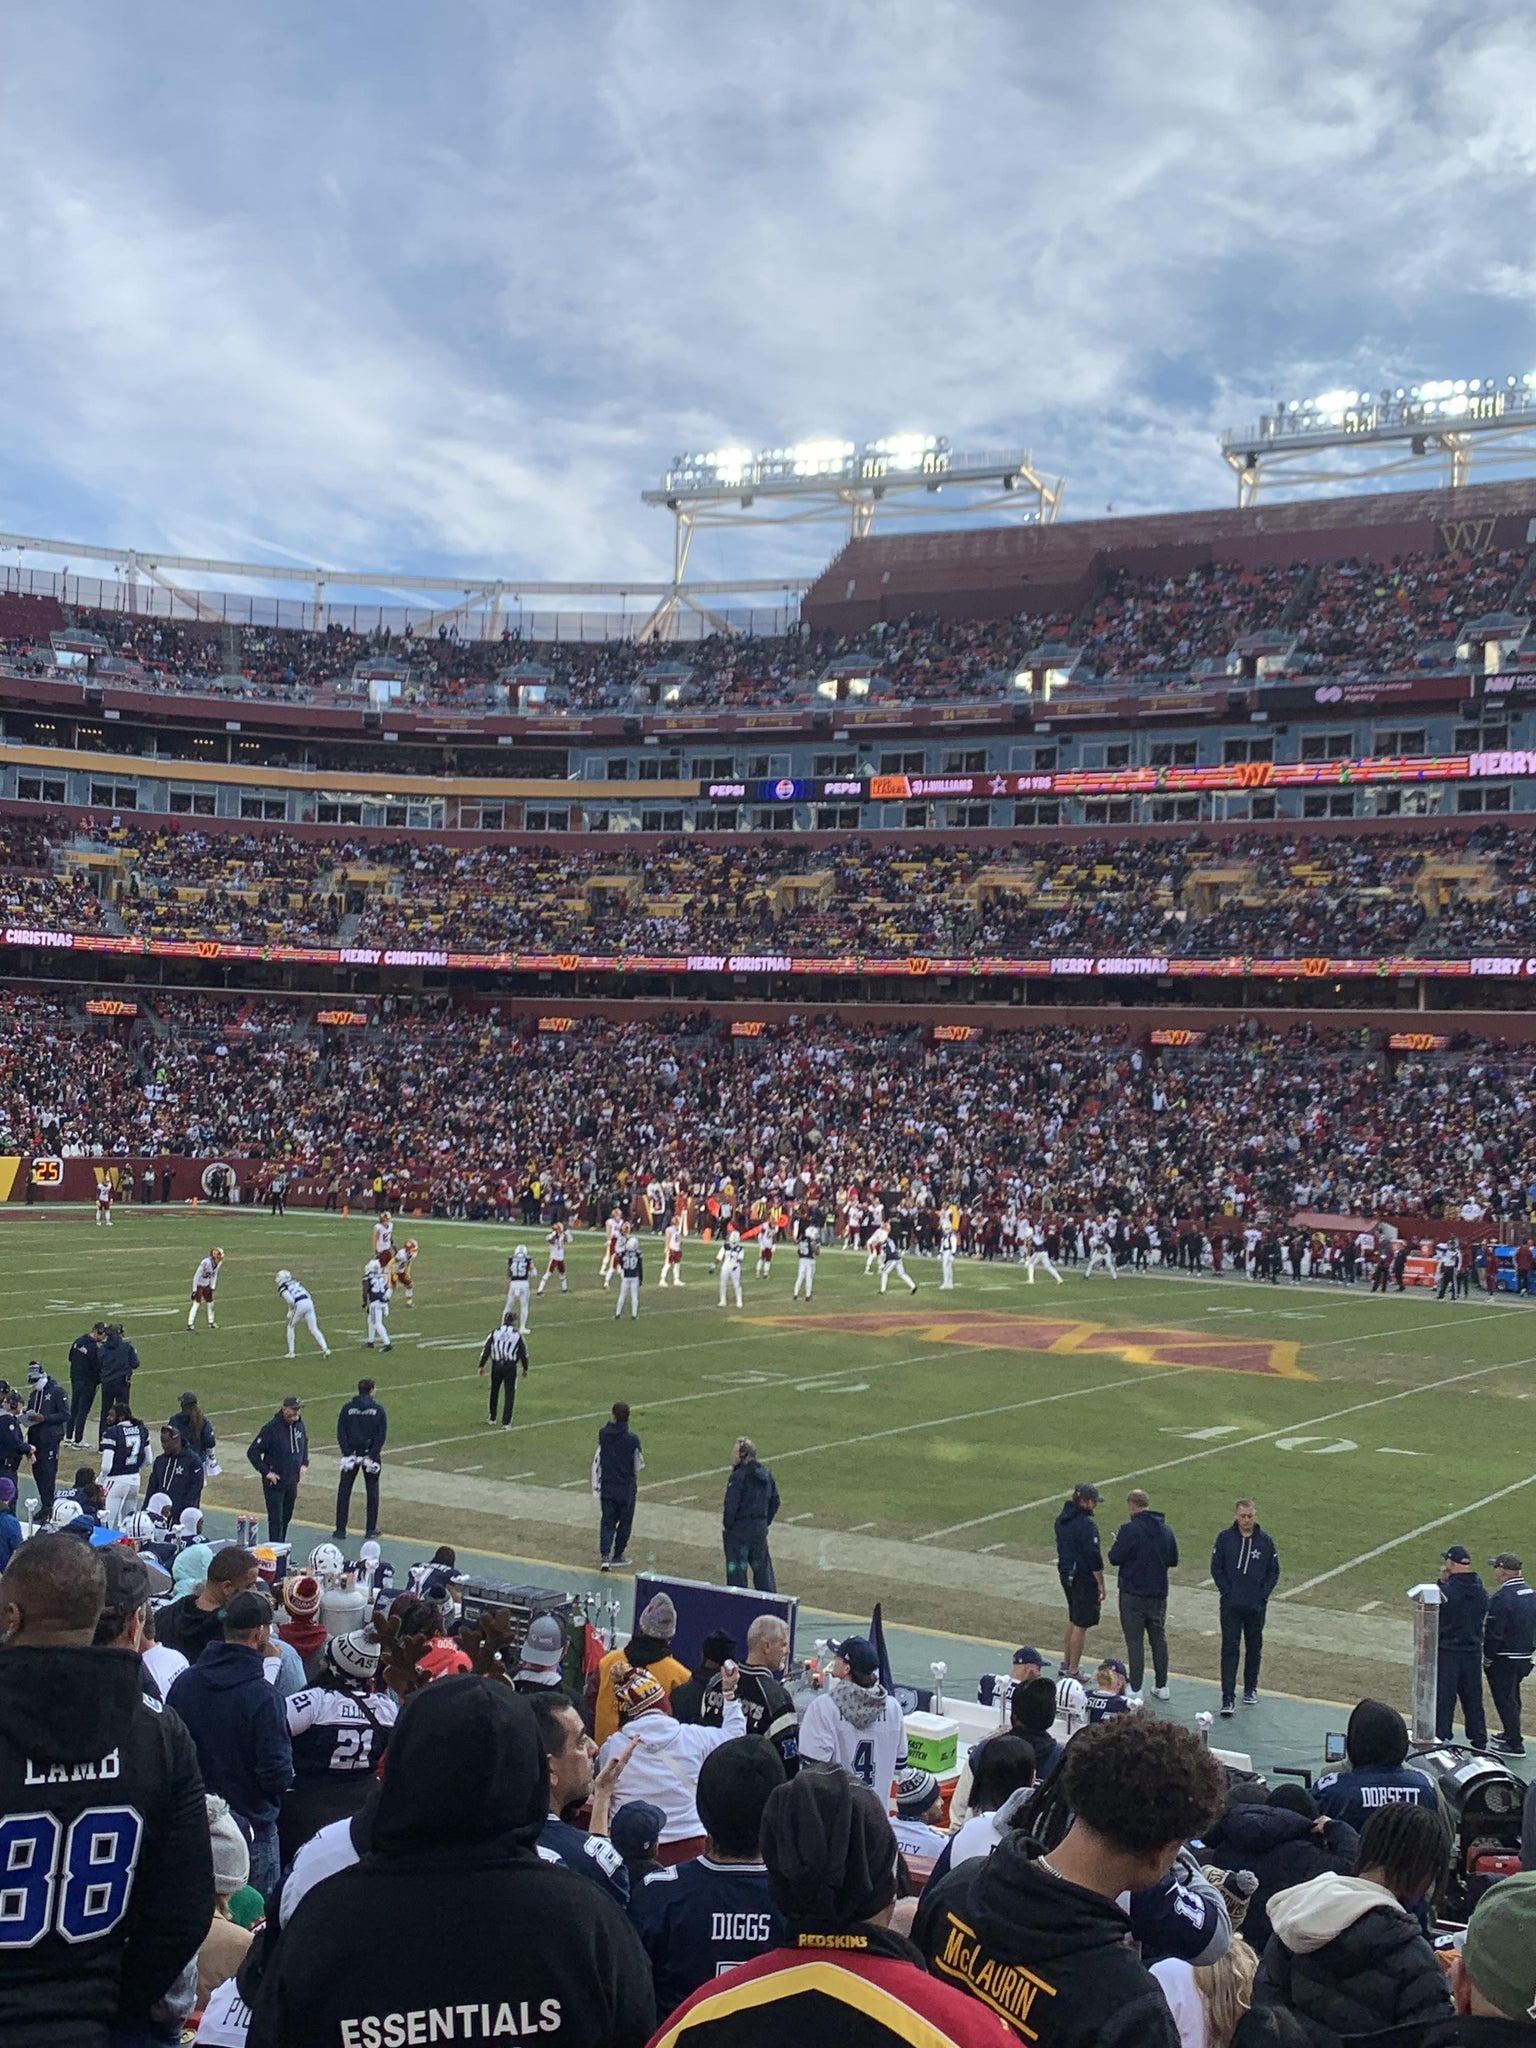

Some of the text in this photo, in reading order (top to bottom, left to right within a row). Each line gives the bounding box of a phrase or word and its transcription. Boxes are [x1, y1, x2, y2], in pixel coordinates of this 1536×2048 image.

[709, 784, 745, 797] PEPSI
[824, 782, 861, 795] PEPSI
[6, 929, 74, 948] CHRISTMAS
[340, 948, 448, 967] MERRY CHRISTMAS
[687, 956, 792, 972] MERRY CHRISTMAS
[1050, 957, 1169, 974] MERRY CHRISTMAS
[1470, 957, 1523, 975] MERRY
[37, 1162, 58, 1181] 25
[125, 1435, 142, 1466] 7
[329, 1728, 374, 1769] 21
[851, 1739, 876, 1787] 4
[1360, 1786, 1421, 1808] DORSETT
[0, 1804, 145, 1949] 88
[711, 1912, 772, 1942] DIGGS
[798, 1933, 868, 1949] REDSKINS
[943, 1926, 1037, 2022] McLAURIN
[340, 1998, 562, 2048] ESSENTIALS
